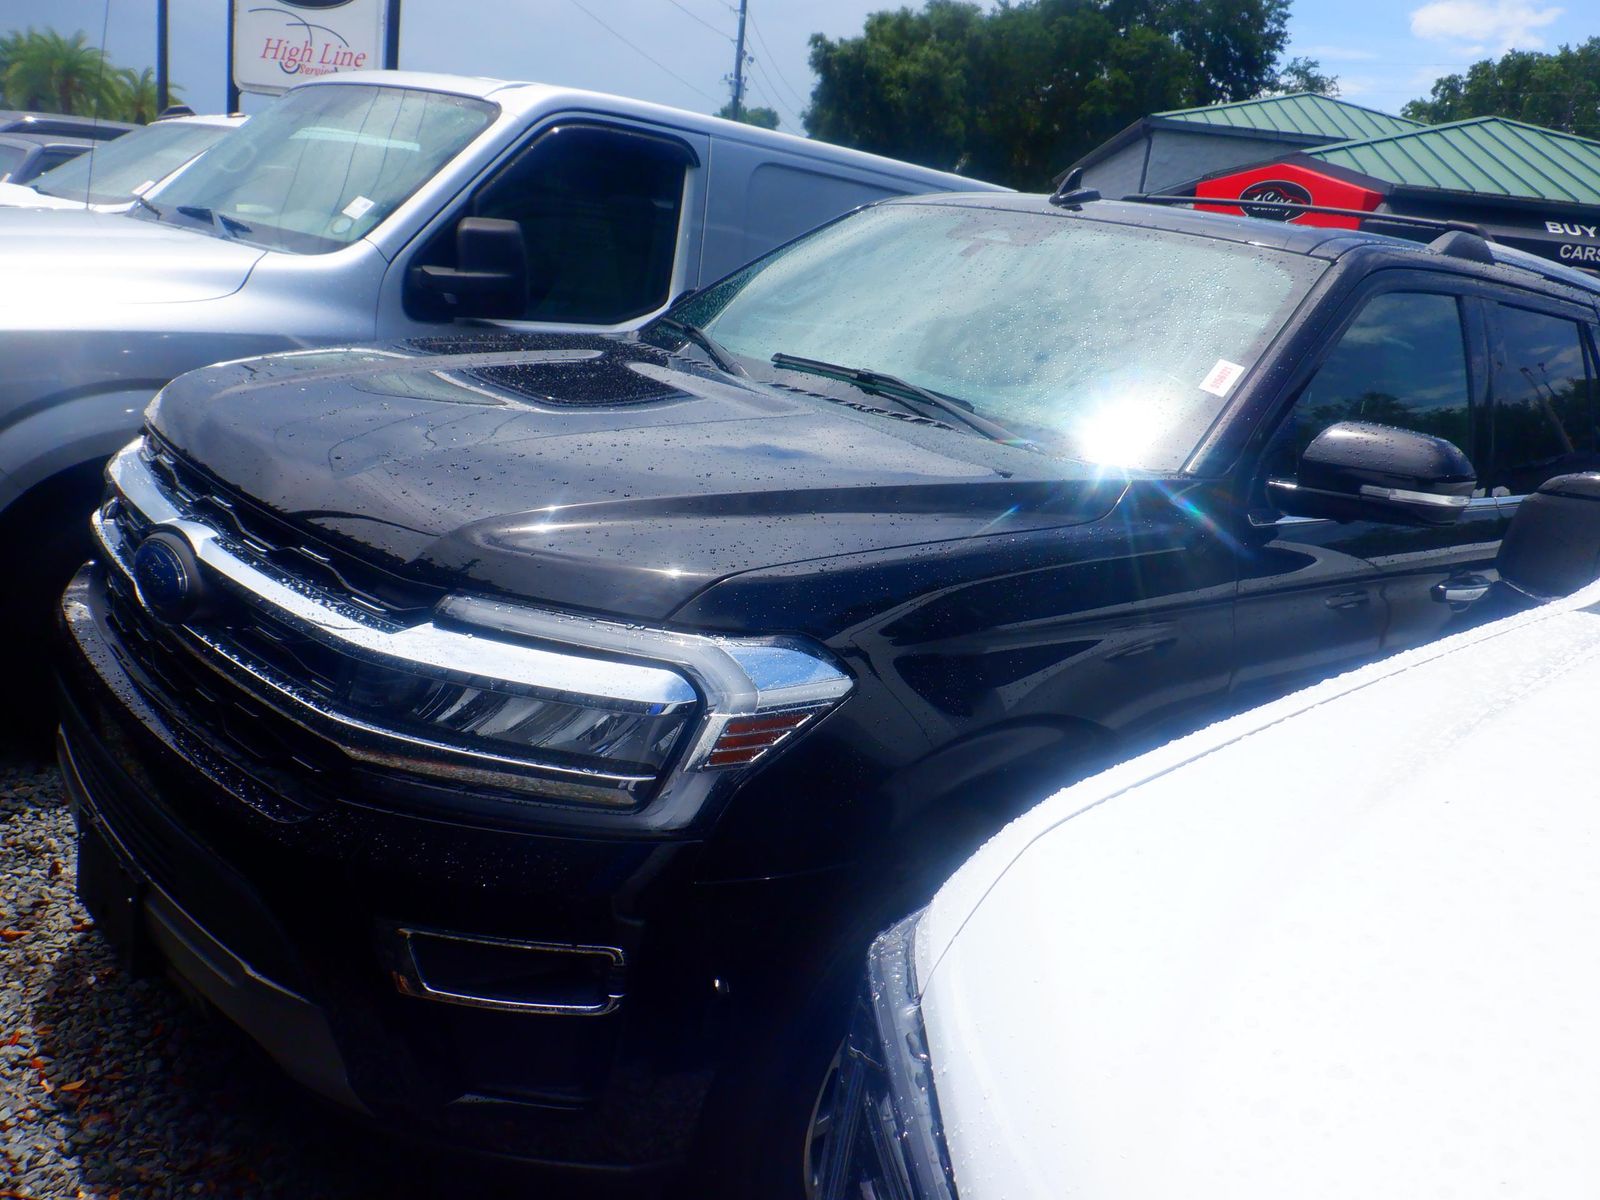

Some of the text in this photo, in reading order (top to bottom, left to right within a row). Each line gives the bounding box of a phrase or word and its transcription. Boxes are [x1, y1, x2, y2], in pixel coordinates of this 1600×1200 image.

[260, 38, 366, 68] High Line
[1545, 221, 1597, 238] BUY
